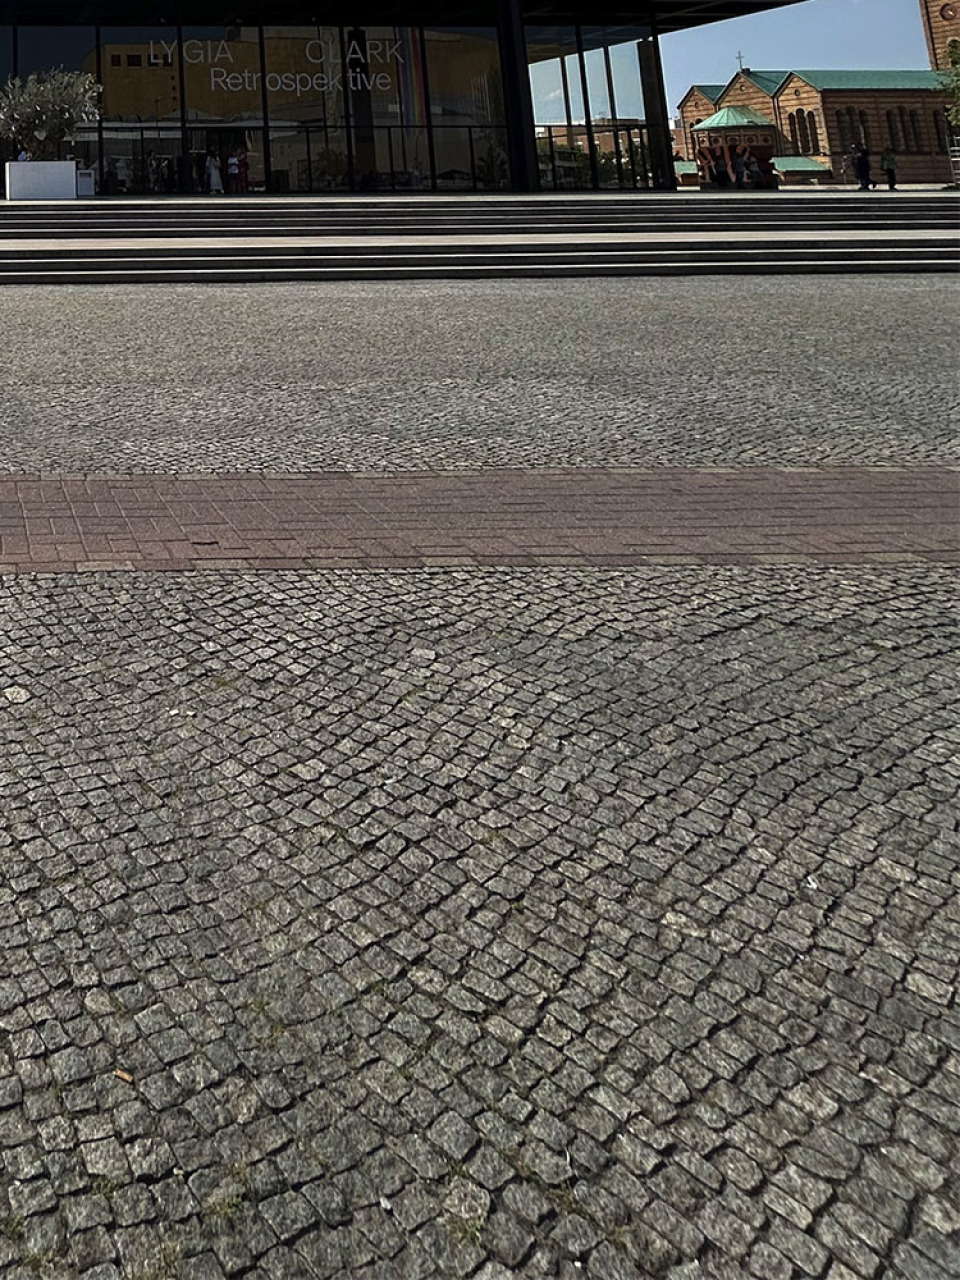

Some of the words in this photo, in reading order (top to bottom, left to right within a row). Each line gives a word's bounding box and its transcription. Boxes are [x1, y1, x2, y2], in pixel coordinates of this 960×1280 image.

[149, 40, 234, 64] LYGIA
[304, 40, 405, 64] CLARK
[210, 67, 392, 96] Retrospektive
